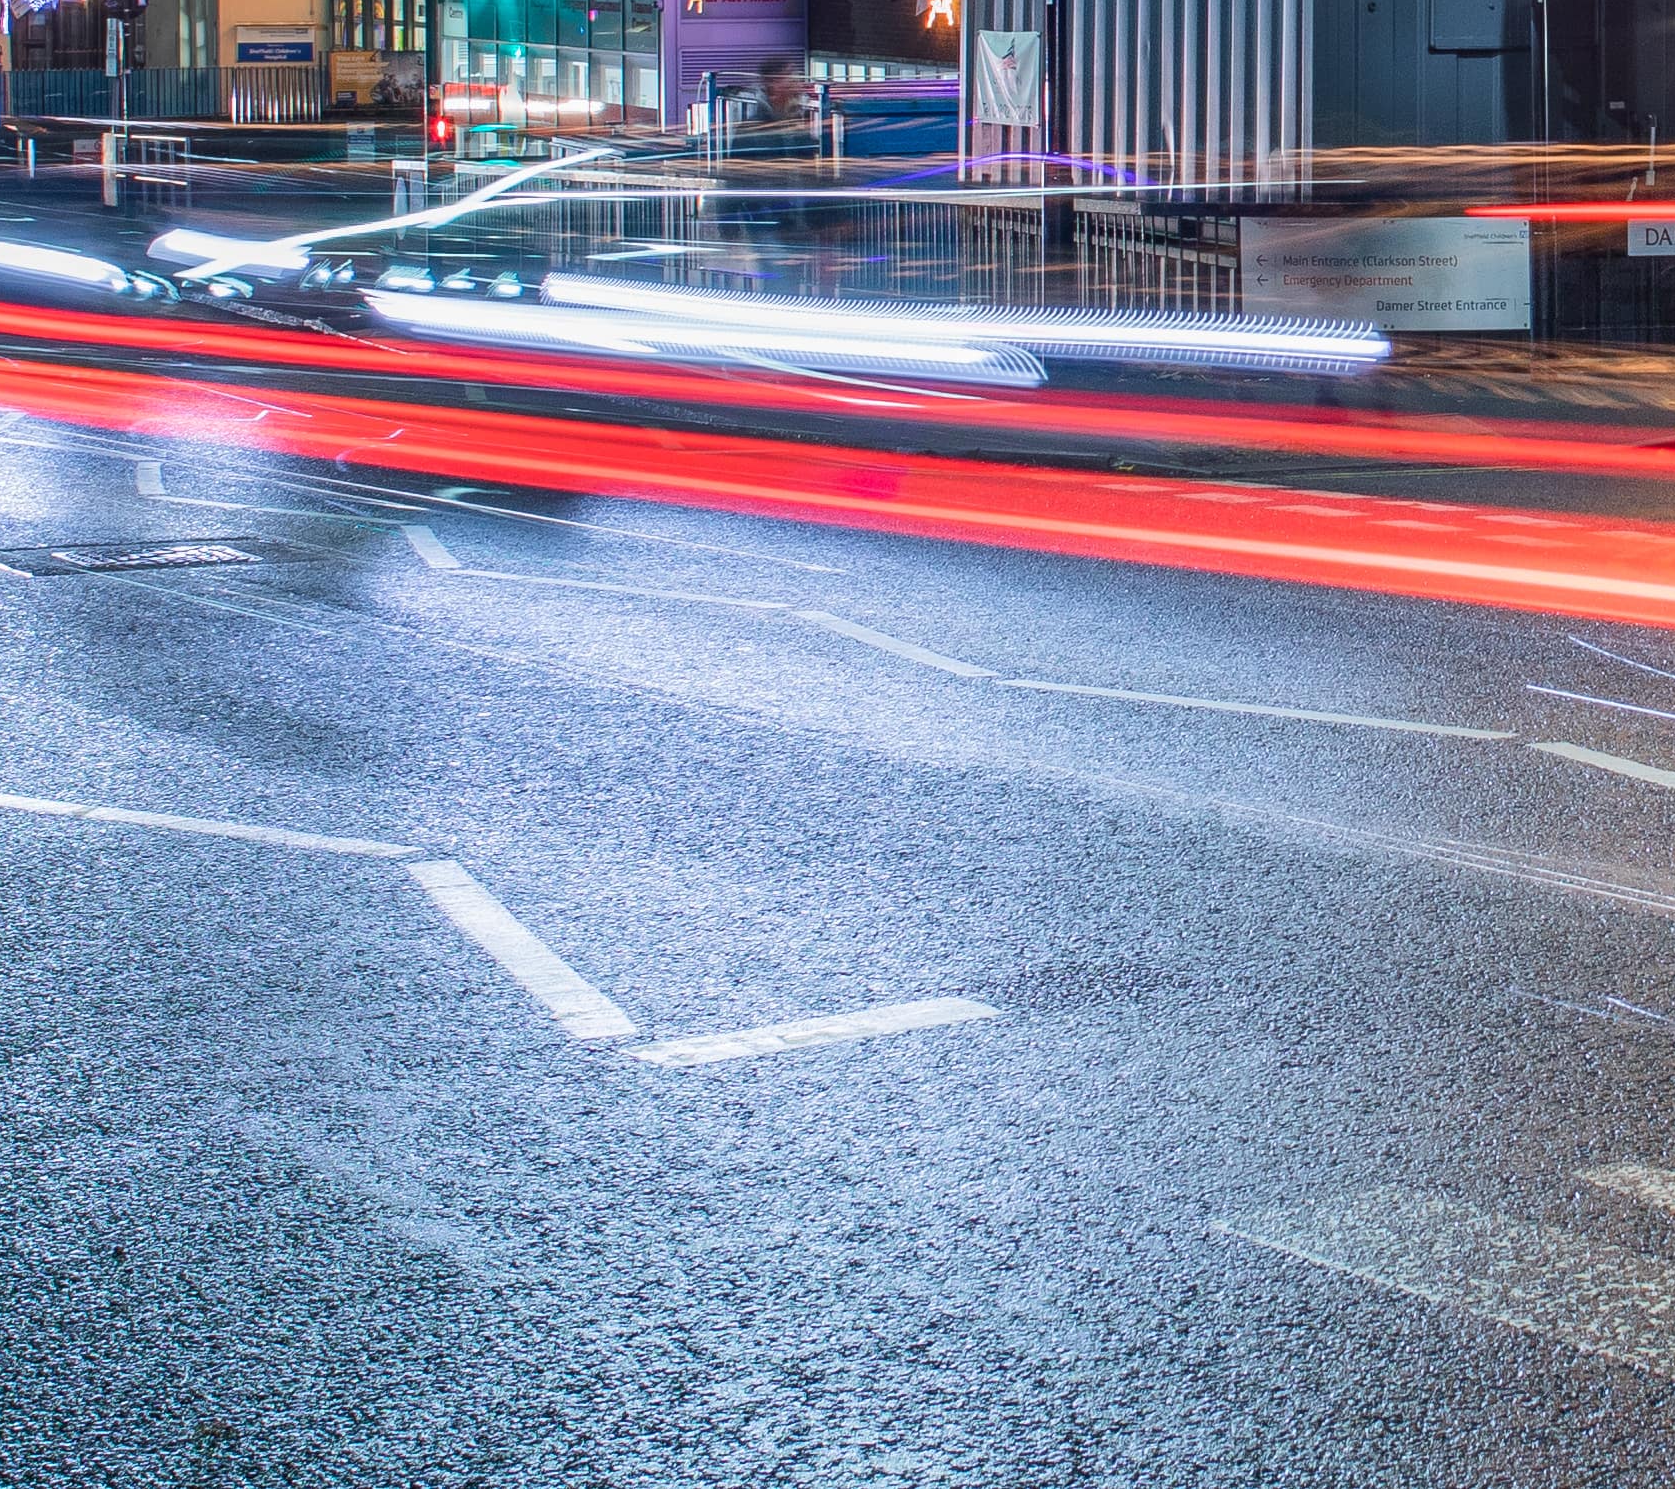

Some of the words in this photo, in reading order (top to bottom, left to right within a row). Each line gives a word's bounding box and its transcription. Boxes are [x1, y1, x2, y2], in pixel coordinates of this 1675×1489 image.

[1283, 254, 1308, 266] Main
[1311, 254, 1360, 266] Entrance
[1362, 254, 1416, 268] (Clarkson
[1418, 254, 1458, 268] Street)
[1283, 274, 1341, 288] Emergency
[1344, 274, 1413, 288] Department
[1376, 299, 1413, 312] Damer
[1417, 299, 1453, 312] Street
[1455, 299, 1507, 311] Entrance
